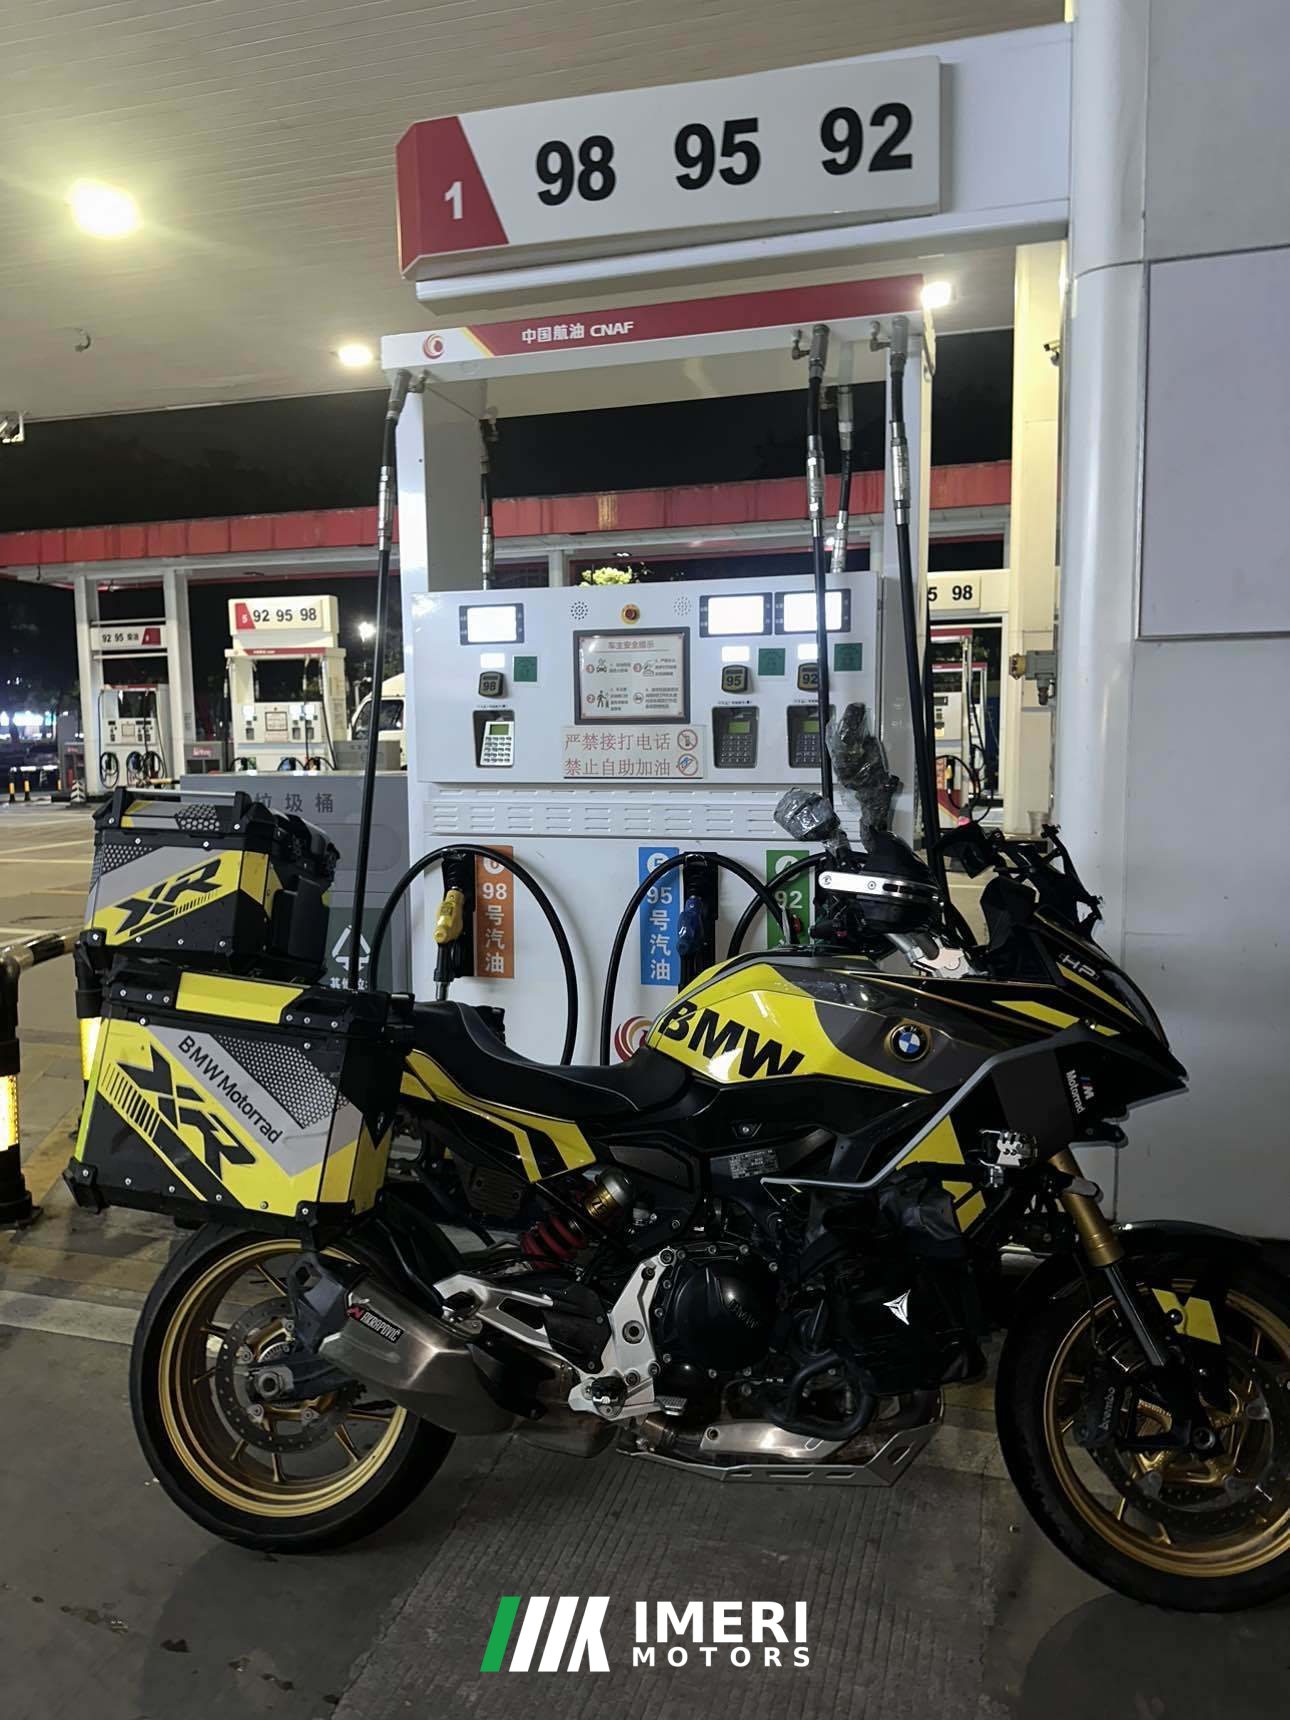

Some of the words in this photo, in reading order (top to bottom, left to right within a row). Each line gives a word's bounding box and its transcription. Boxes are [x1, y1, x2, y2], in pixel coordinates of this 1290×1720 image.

[444, 181, 464, 220] 1
[535, 135, 616, 206] 98
[674, 117, 760, 190] 95
[820, 102, 913, 176] 92
[521, 323, 585, 344] 中国航油
[590, 321, 634, 337] CNAF
[951, 584, 973, 601] 98
[252, 609, 270, 623] 92
[276, 608, 293, 622] 95
[299, 607, 317, 621] 98
[102, 633, 111, 643] 92
[482, 681, 497, 691] 98
[726, 675, 742, 687] 95
[564, 732, 671, 752] 严禁接打电话
[565, 758, 671, 777] 禁止自助加油
[1062, 954, 1096, 978] HP
[657, 999, 806, 1079] BMW
[178, 1035, 219, 1083] BMW
[217, 1073, 284, 1145] Motorrad
[1065, 1069, 1086, 1114] Motorrad
